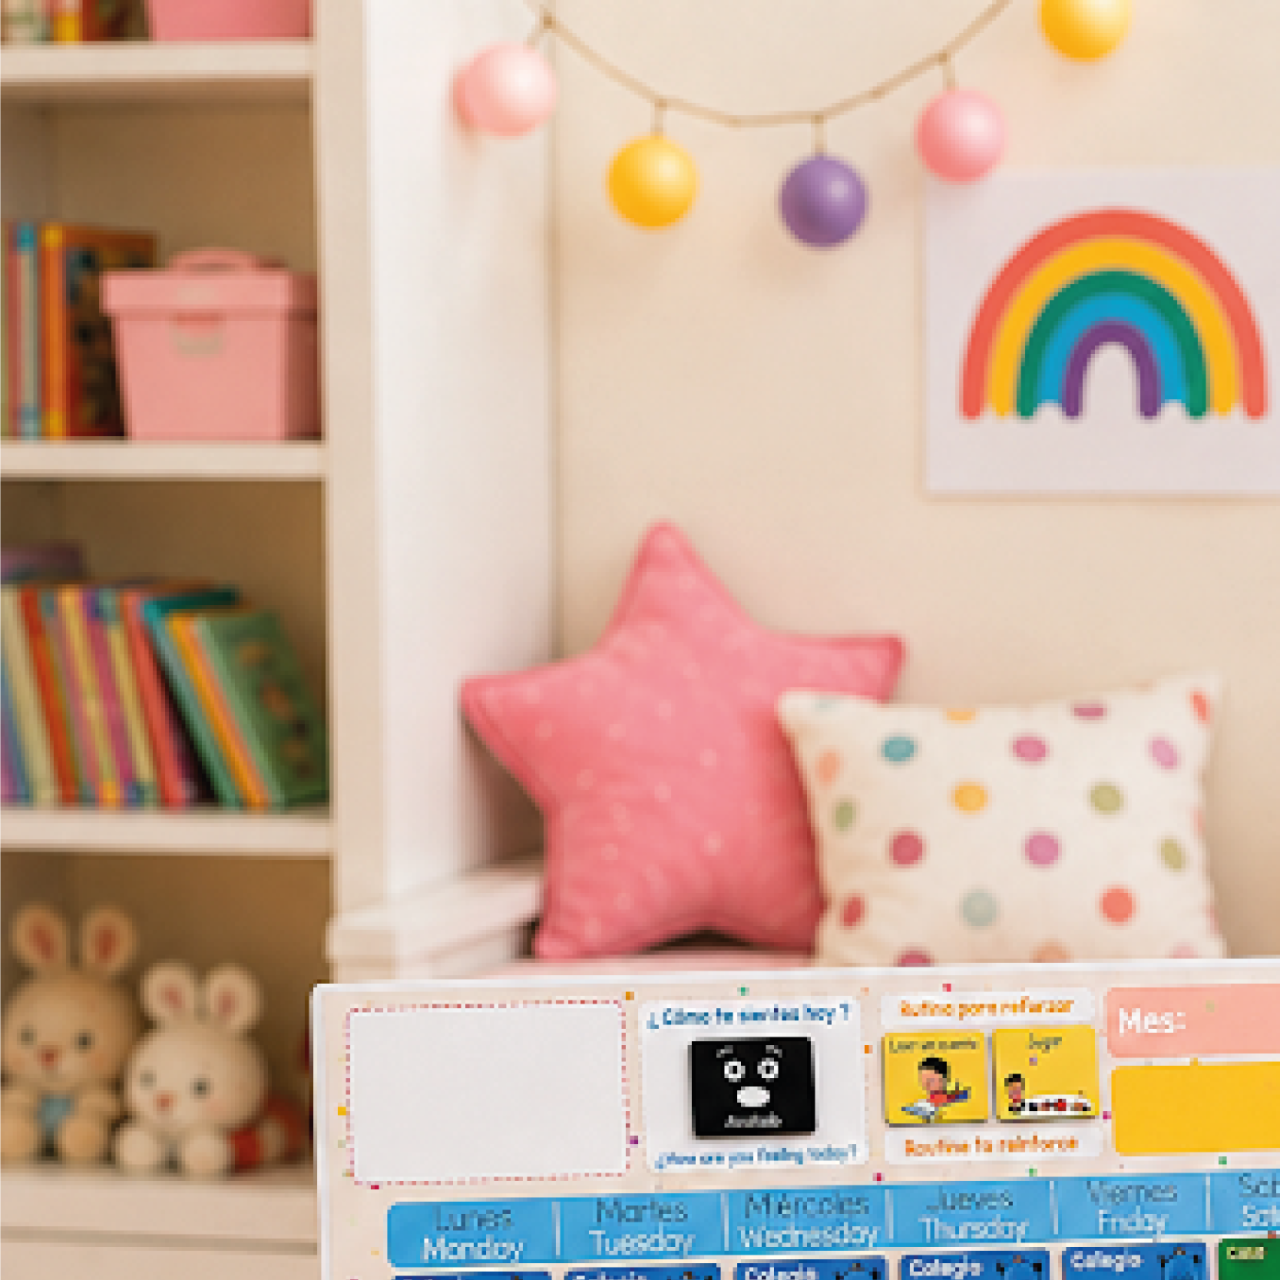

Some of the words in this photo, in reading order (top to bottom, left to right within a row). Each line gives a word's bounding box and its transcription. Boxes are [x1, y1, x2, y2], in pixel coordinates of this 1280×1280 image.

[1118, 1007, 1187, 1035] Mes:
[926, 1185, 1014, 1211] Jueves
[1086, 1180, 1179, 1205] Viernes
[436, 1204, 515, 1232] Lunes
[593, 1197, 689, 1223] Martes
[1098, 1205, 1171, 1239] Friday
[588, 1222, 697, 1259] Tuesday
[737, 1222, 882, 1249] Wednesday
[918, 1214, 1030, 1244] Thursday
[420, 1233, 525, 1263] Monday
[1069, 1248, 1145, 1272] Colegio
[908, 1254, 985, 1280] Colegio
